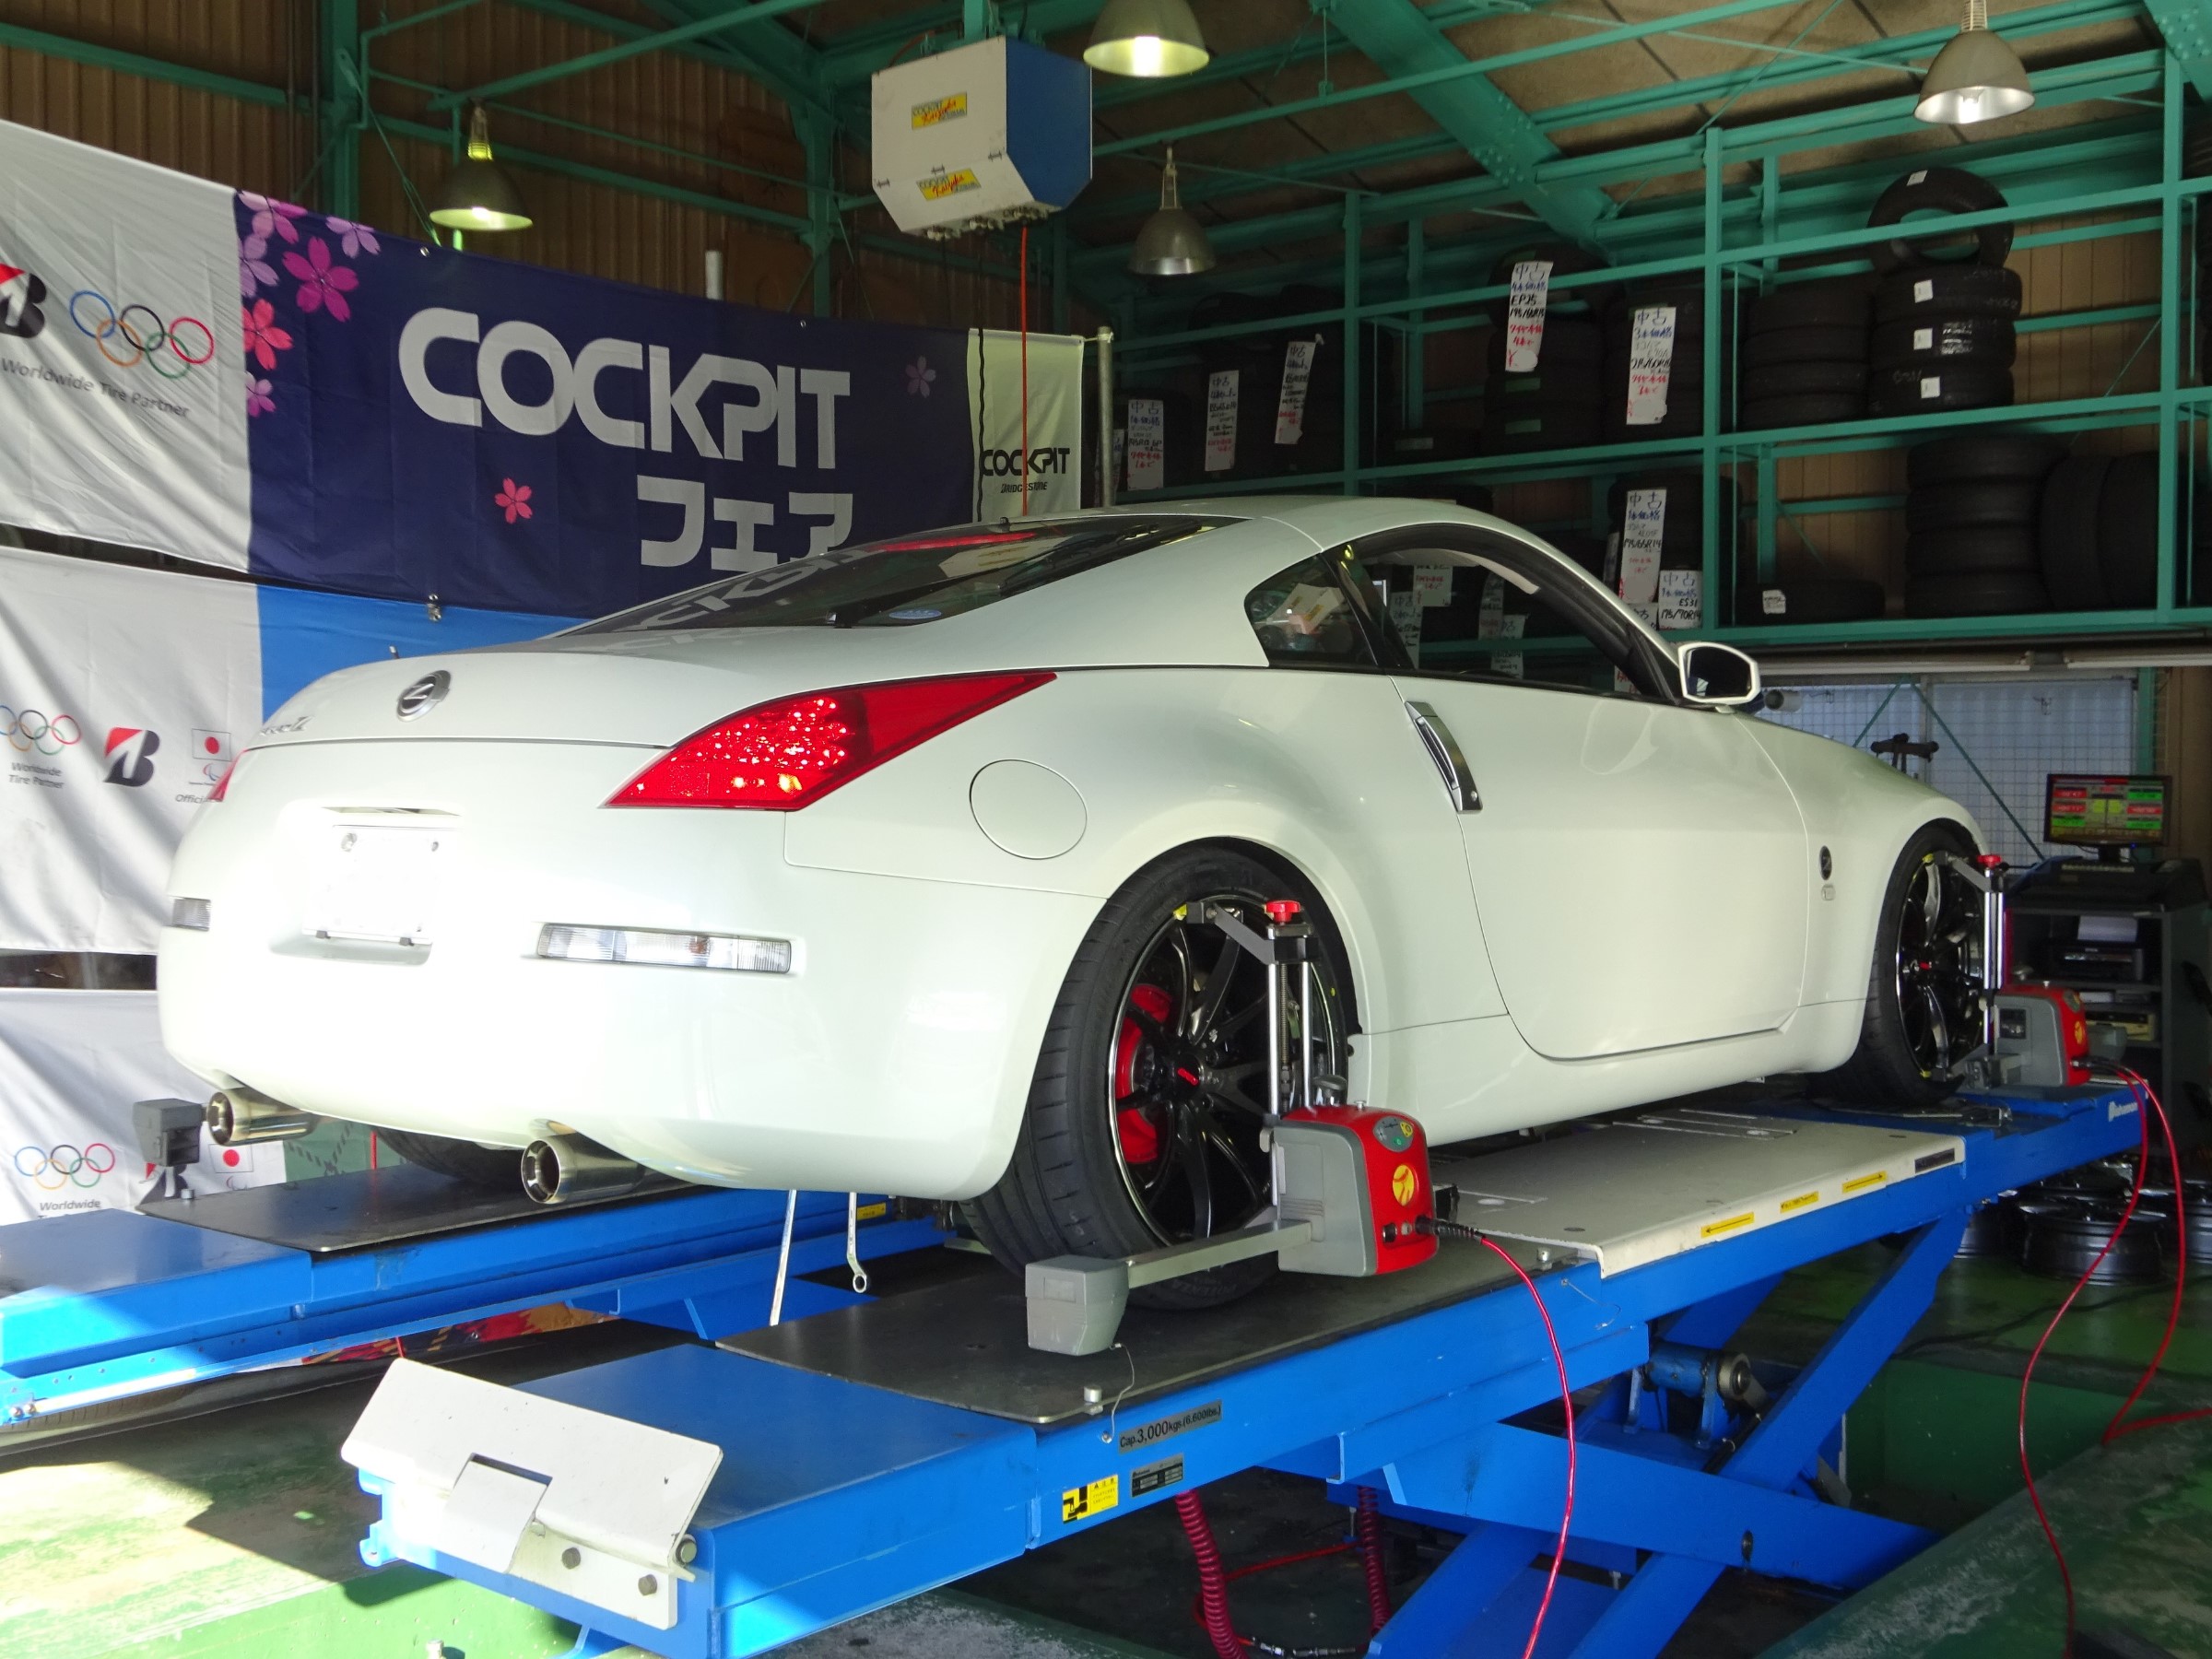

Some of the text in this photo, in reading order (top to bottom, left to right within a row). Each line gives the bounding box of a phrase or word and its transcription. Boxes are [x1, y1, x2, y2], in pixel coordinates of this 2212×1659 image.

[1511, 294, 1536, 305] EP25
[1637, 308, 1666, 325] 中古
[1, 358, 190, 418] Worldwide Tire Partner
[398, 307, 851, 469] COCKPIT
[979, 447, 1070, 477] COCKPIT
[1630, 491, 1663, 509] 中古
[637, 475, 853, 569] フェア
[1664, 571, 1695, 586] 中古
[1679, 598, 1698, 606] ES31
[40, 1199, 101, 1211] Worldwide
